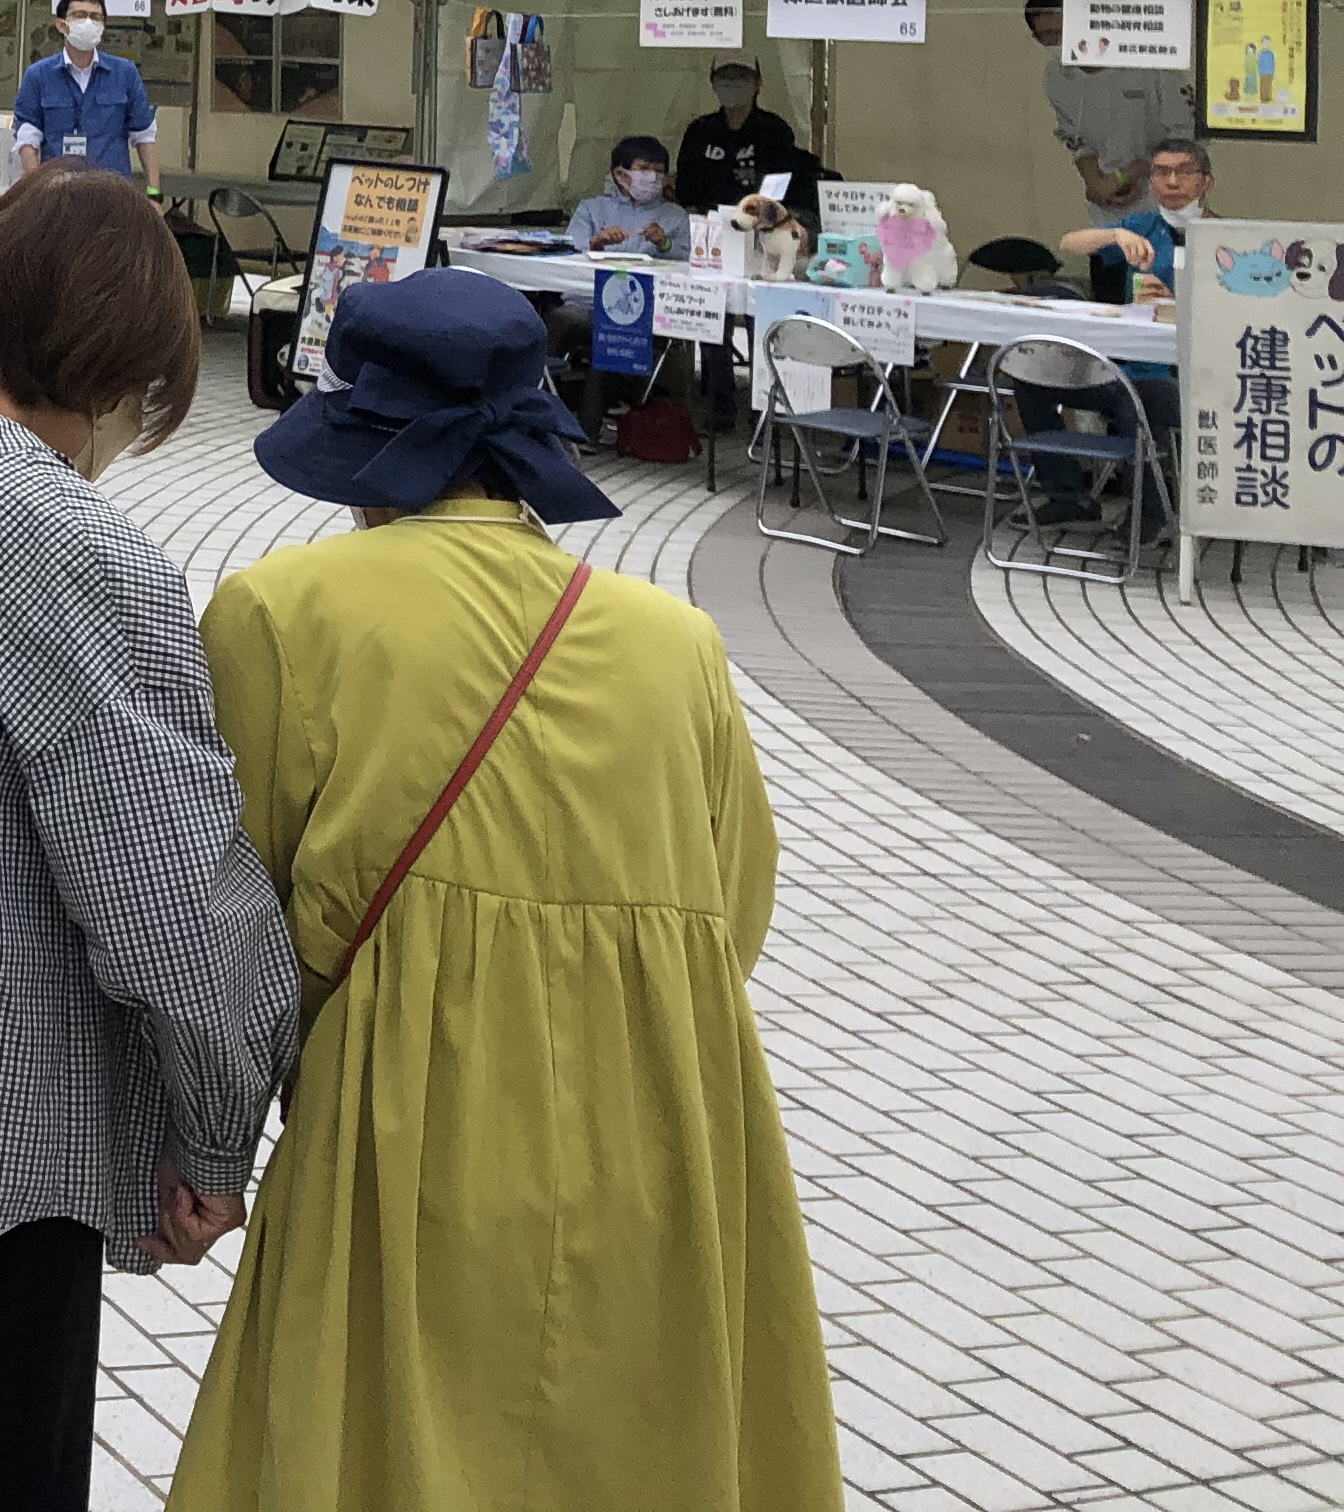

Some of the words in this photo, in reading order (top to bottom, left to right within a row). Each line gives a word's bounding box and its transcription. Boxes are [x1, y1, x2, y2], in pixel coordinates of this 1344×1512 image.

[134, 0, 146, 13] 66
[351, 172, 430, 194] ペットのしつけ
[1233, 325, 1292, 510] 健康相談
[1197, 409, 1219, 506] 獣医師会
